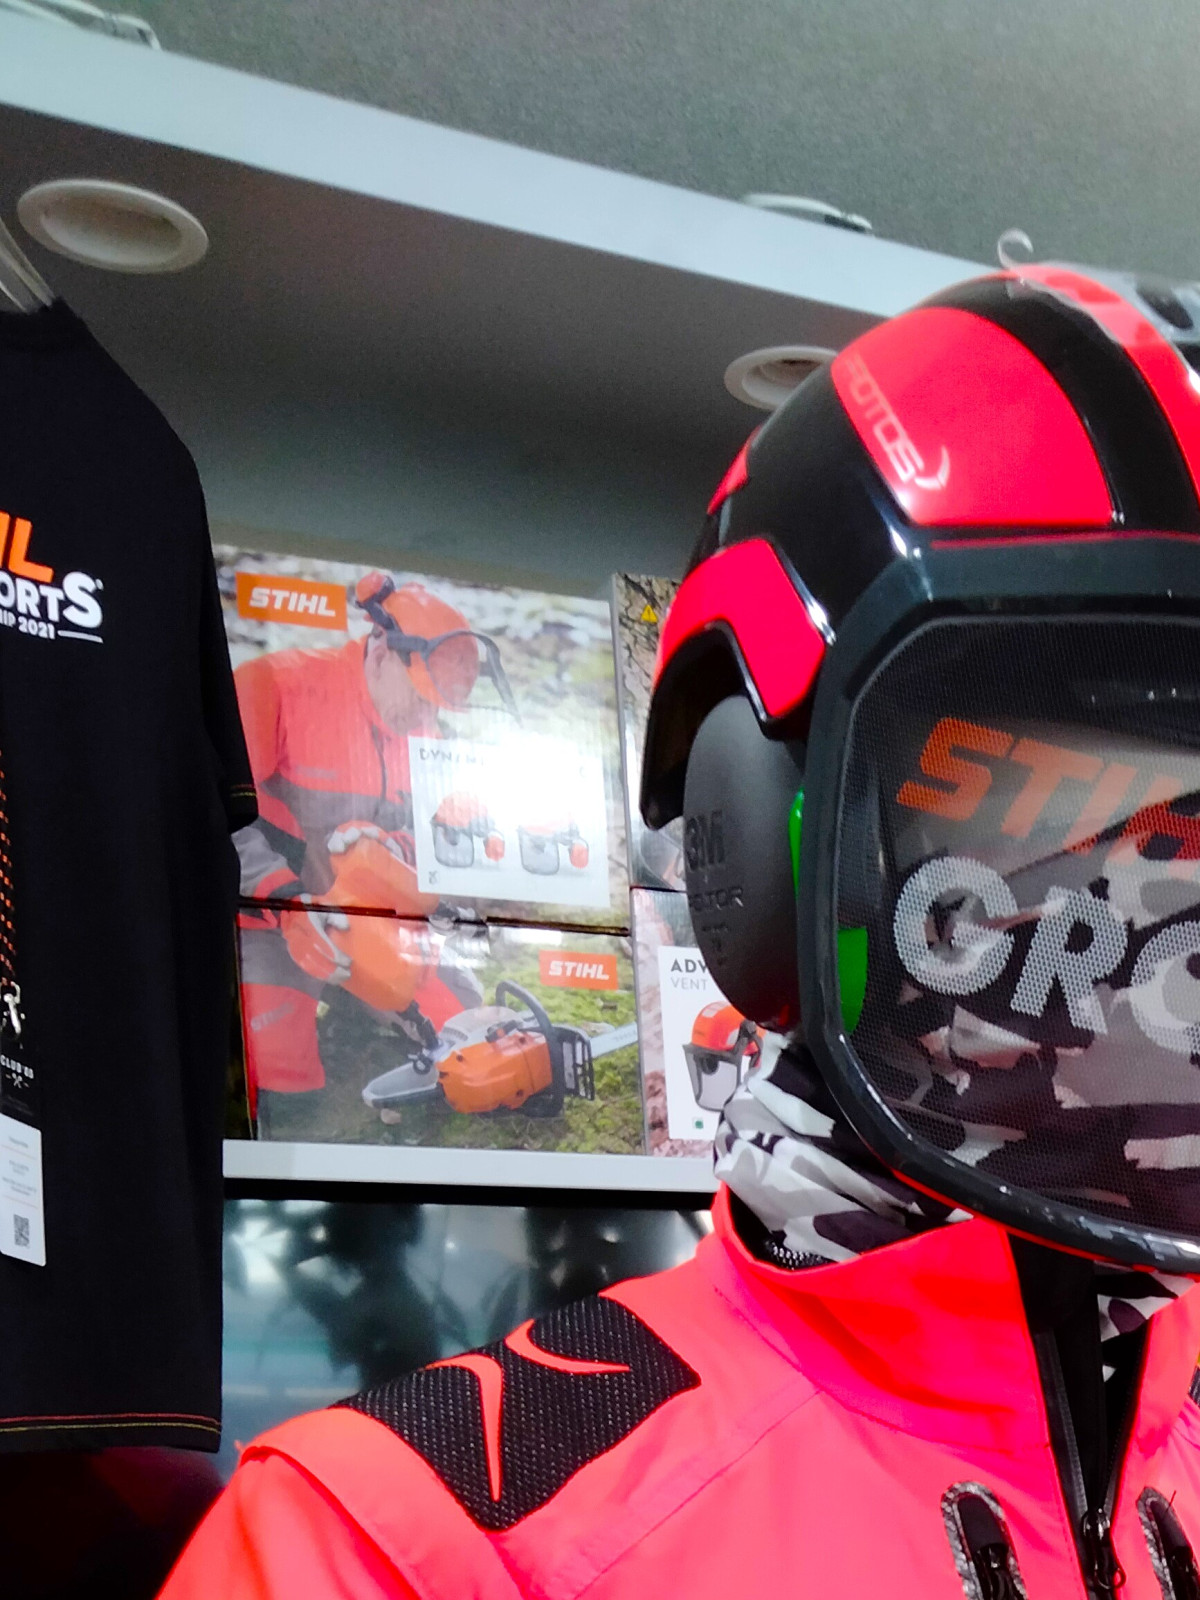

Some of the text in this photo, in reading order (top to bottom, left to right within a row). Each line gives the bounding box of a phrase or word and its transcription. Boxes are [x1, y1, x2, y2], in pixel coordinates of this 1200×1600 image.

[250, 588, 336, 617] STIHL
[17, 616, 55, 639] 2021
[548, 960, 611, 980] STIHL
